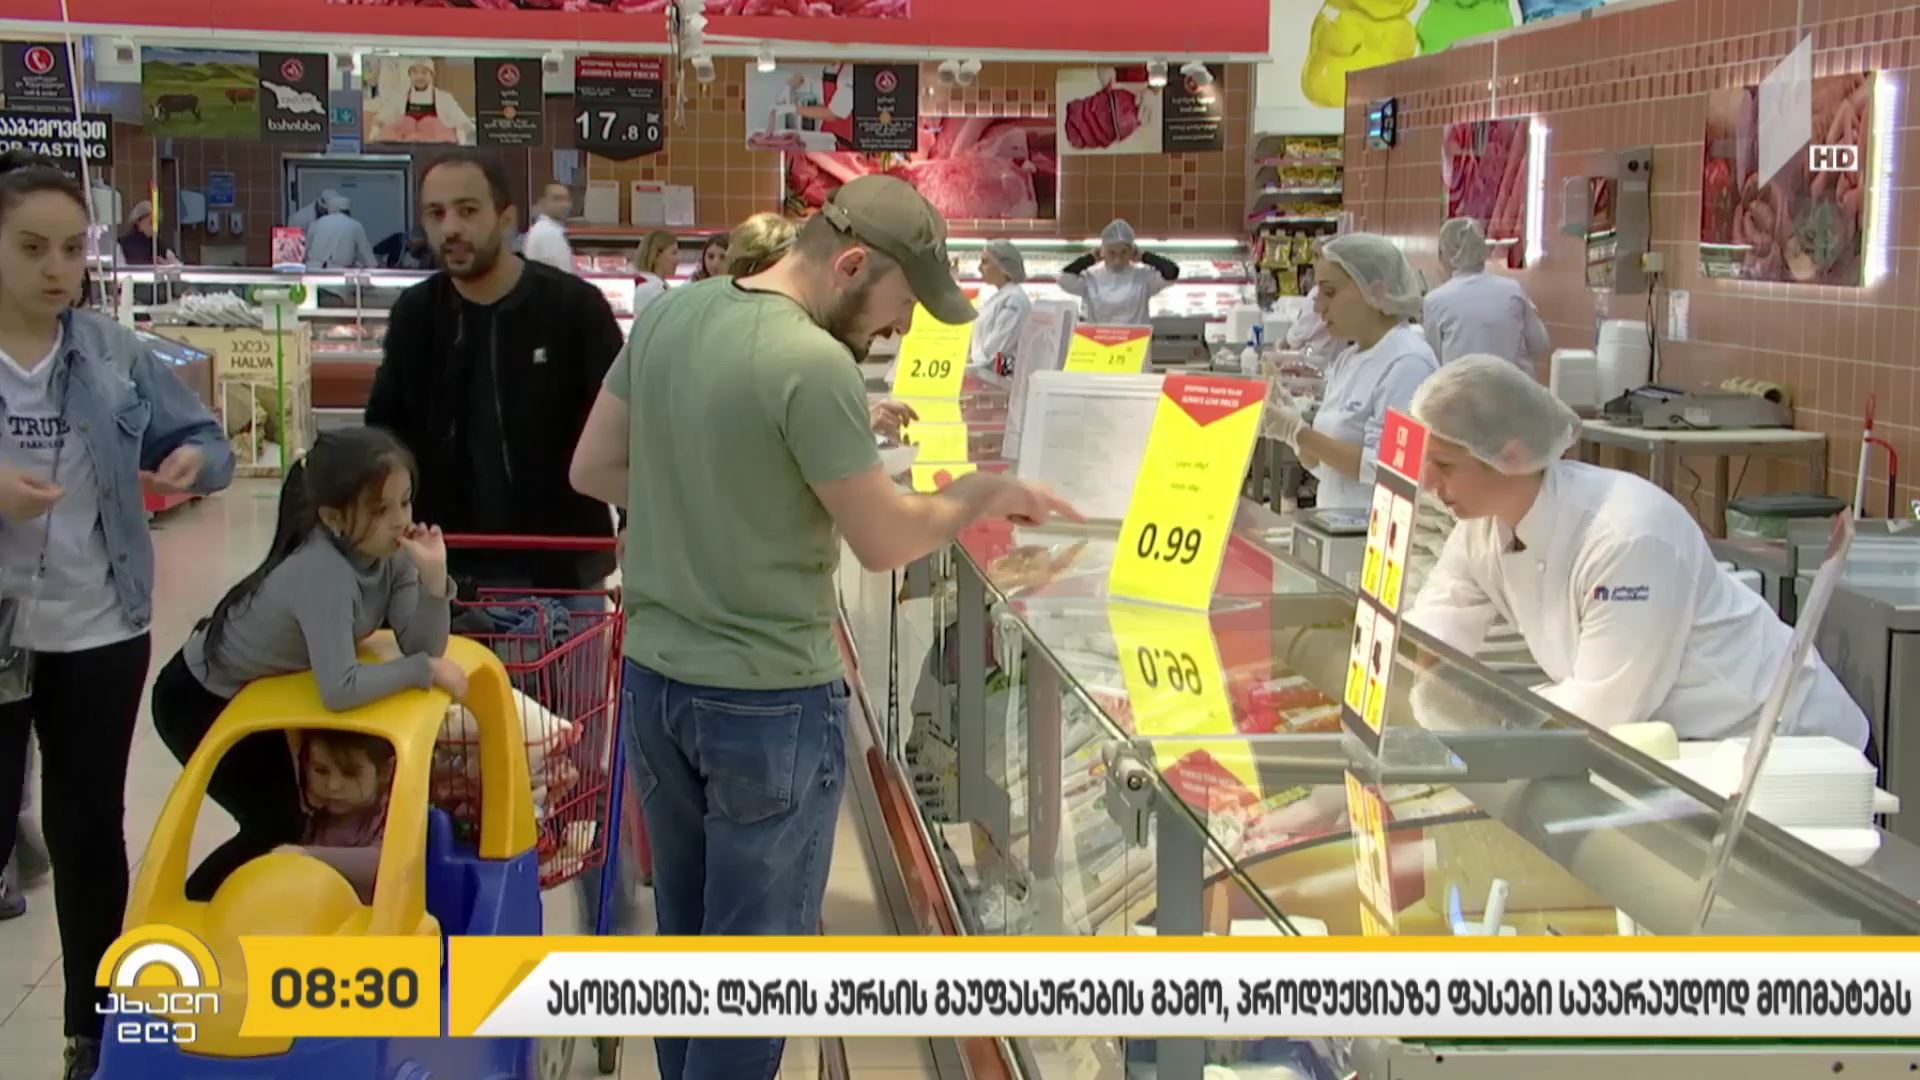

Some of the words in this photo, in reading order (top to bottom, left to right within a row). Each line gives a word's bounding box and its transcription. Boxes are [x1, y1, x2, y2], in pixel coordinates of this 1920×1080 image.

[27, 140, 107, 159] TASTING
[231, 356, 274, 369] HALVA
[910, 359, 951, 379] 2.09
[7, 416, 71, 437] TRUE
[1136, 522, 1203, 565] 0.99
